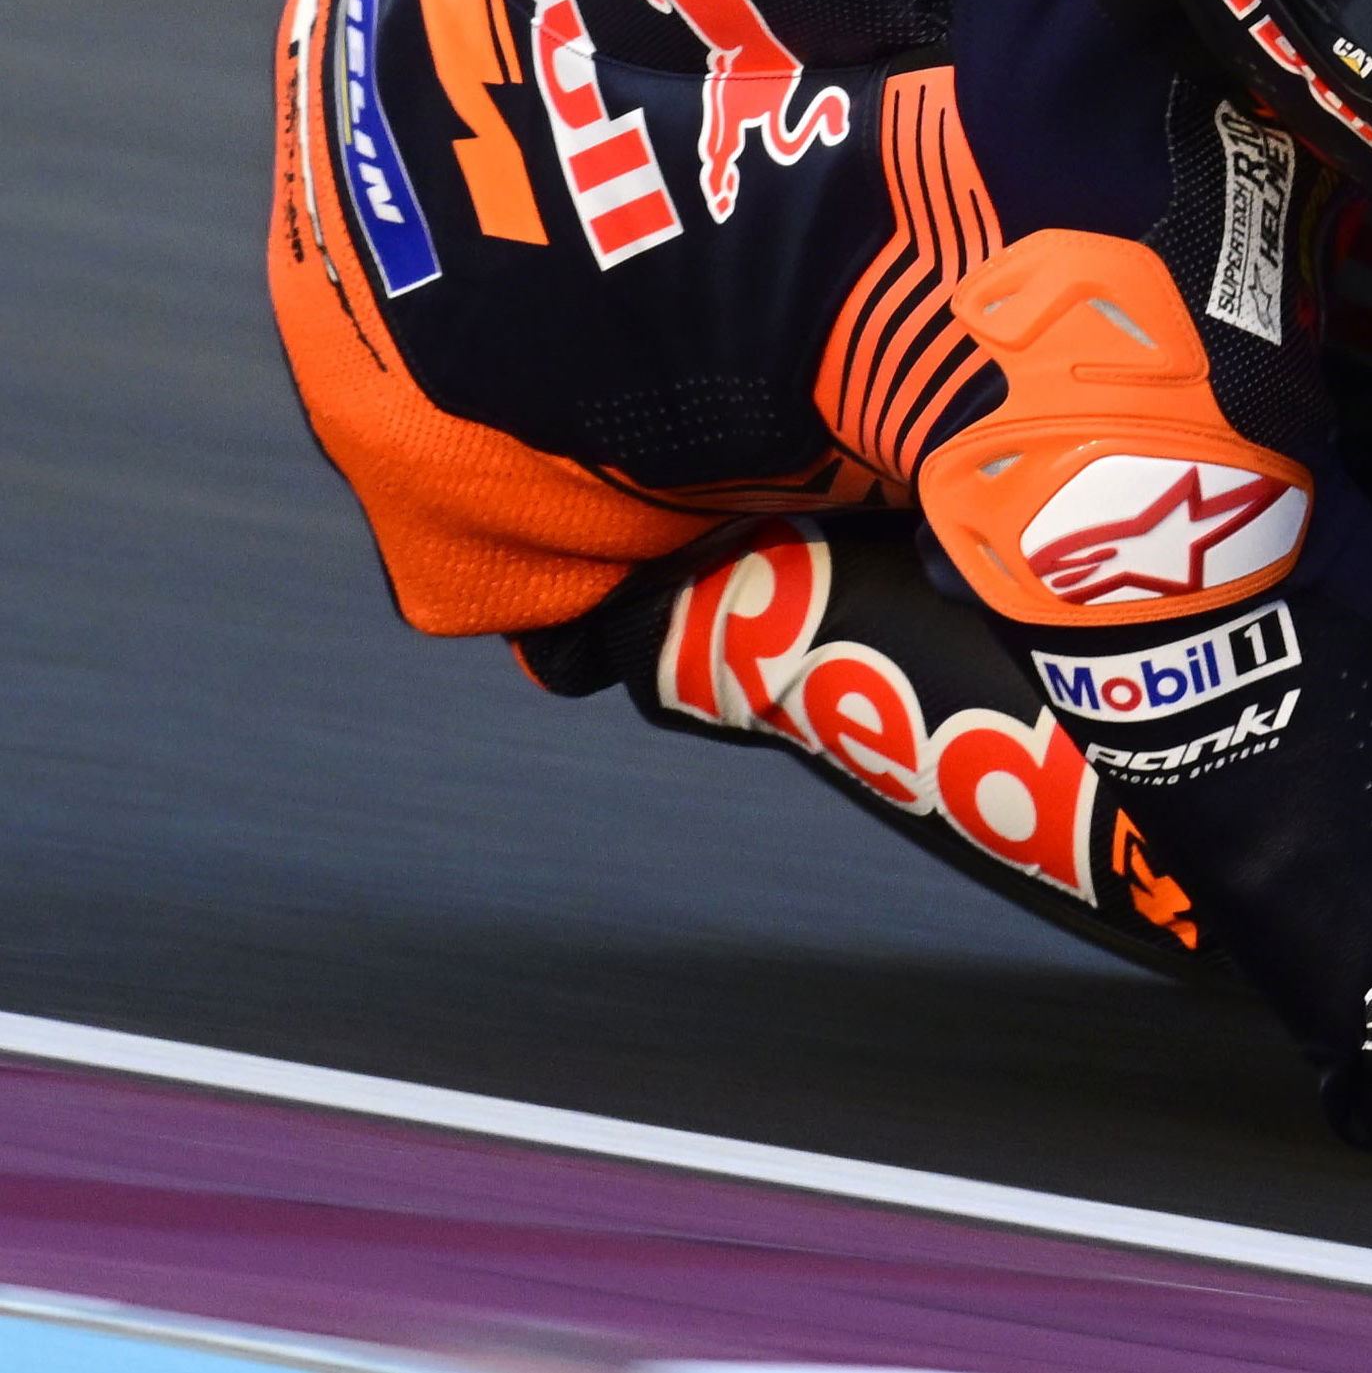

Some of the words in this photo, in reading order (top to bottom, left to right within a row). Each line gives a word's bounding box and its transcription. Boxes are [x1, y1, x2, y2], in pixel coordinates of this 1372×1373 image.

[1218, 180, 1250, 315] SUPERTECH
[660, 516, 1099, 908] Red
[1043, 639, 1222, 712] Mobil
[1085, 687, 1302, 772] pankl
[1188, 735, 1281, 779] SYSTEMS
